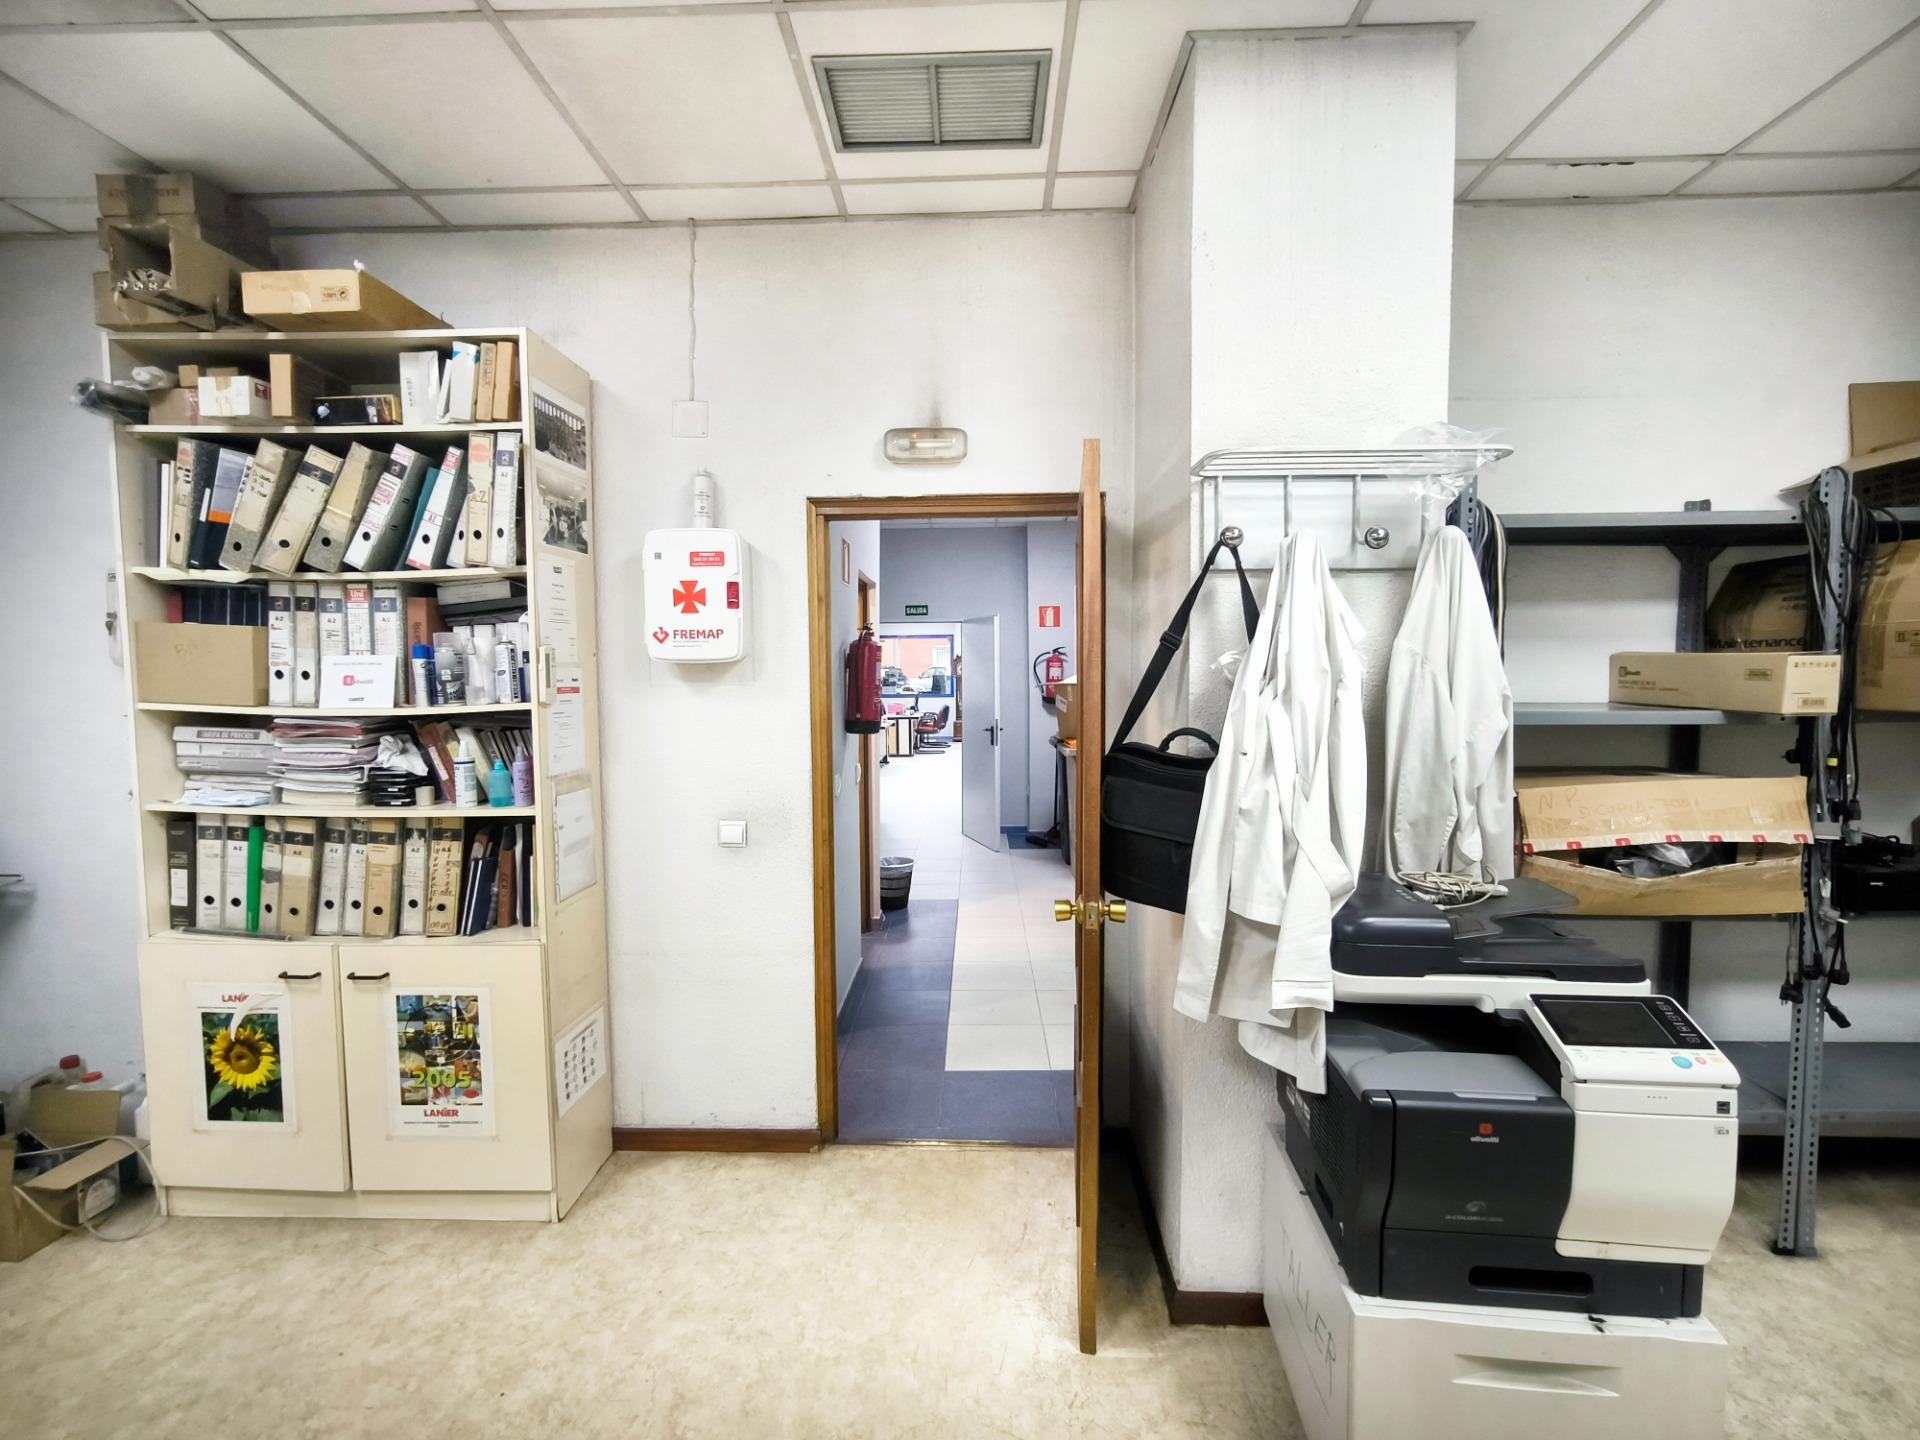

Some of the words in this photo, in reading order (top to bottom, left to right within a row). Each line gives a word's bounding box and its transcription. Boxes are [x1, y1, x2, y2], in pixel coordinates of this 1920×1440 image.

[673, 629, 724, 640] FREMAP
[1709, 637, 1807, 650] Maintenance
[410, 1070, 472, 1088] 2005
